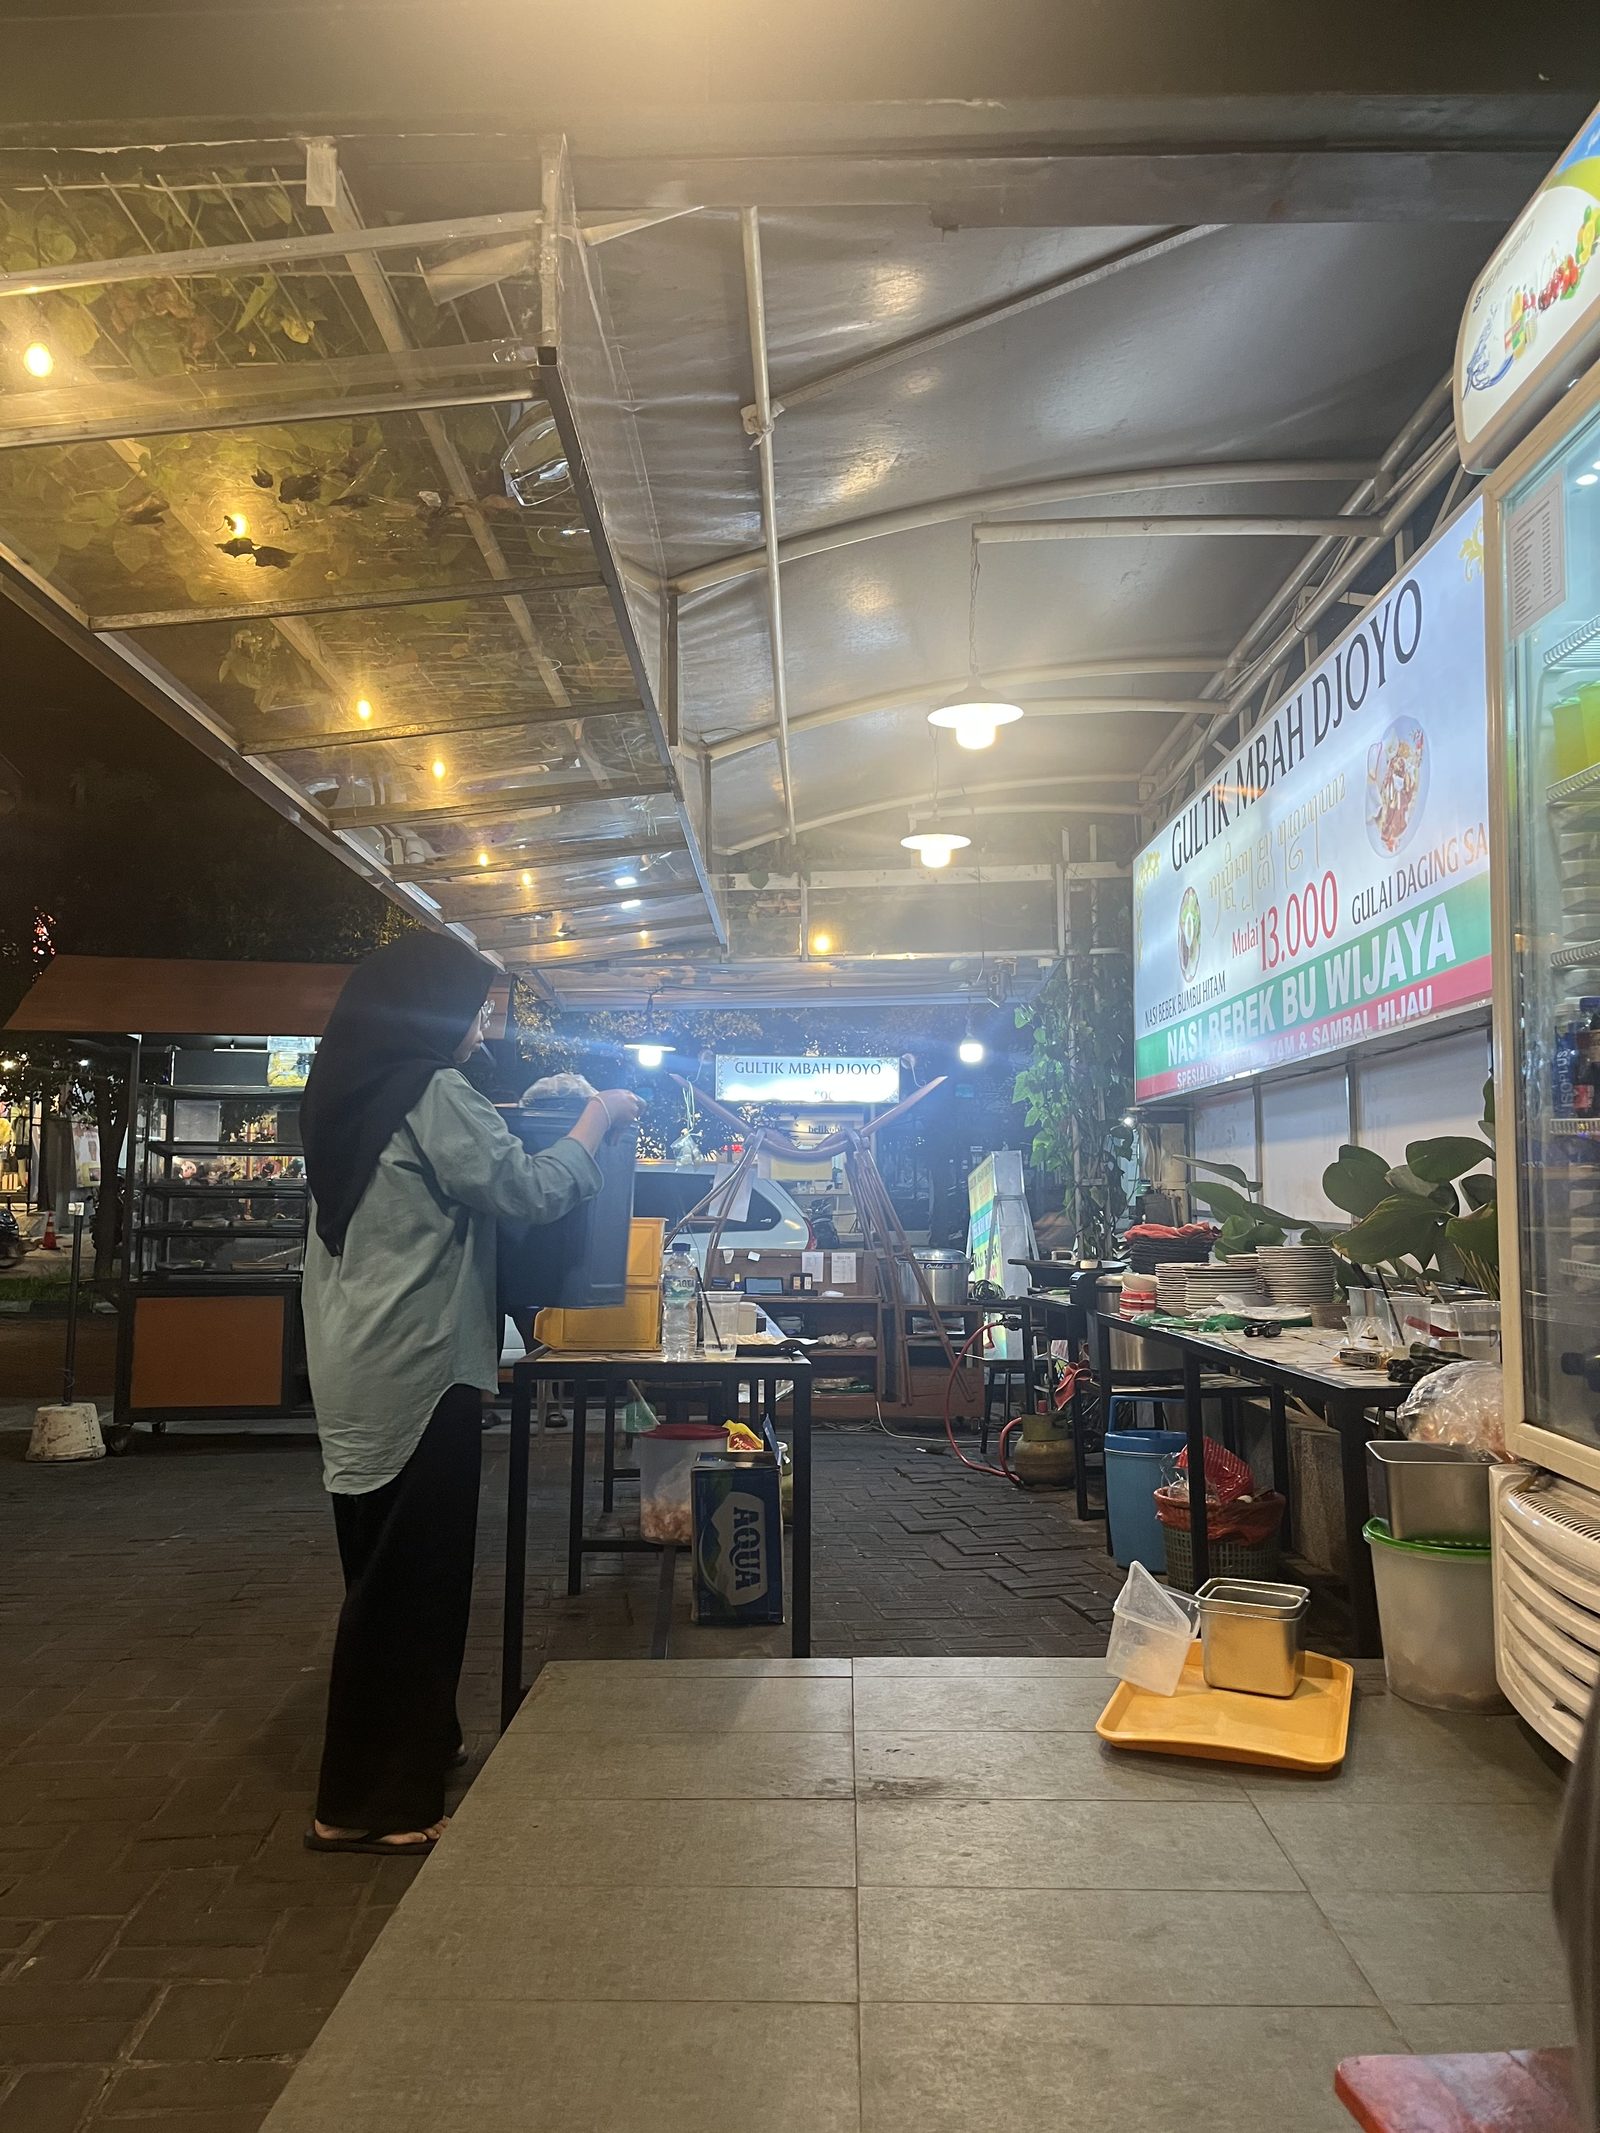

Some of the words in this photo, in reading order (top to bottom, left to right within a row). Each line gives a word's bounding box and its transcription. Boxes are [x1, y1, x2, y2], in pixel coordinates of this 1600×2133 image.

[1171, 771, 1231, 872] GULTIK
[1236, 693, 1305, 818] MBAH
[1312, 578, 1423, 748] DJOYO
[1232, 919, 1259, 959] Mulai
[1260, 870, 1339, 971] 13.000
[1351, 875, 1393, 925] GULAI
[1396, 837, 1459, 903] DAGING
[1144, 1005, 1159, 1029] NASI
[1158, 995, 1177, 1024] BEBEK
[1177, 983, 1202, 1015] BUMBU
[1202, 970, 1227, 1003] HITAM
[1167, 1018, 1204, 1067] NASI
[1207, 985, 1276, 1054] BEBEK
[1281, 966, 1316, 1026] BU
[1324, 902, 1457, 1010] WIJAYA
[1298, 1031, 1308, 1049] &
[1311, 1009, 1371, 1047] SAMBAL
[1377, 985, 1433, 1025] HIJAU
[734, 1062, 784, 1074] GULTIK
[788, 1063, 831, 1075] MBAH
[835, 1063, 881, 1075] DJOYO
[1556, 1048, 1575, 1109] ISOPLUS
[729, 1507, 761, 1591] AQUA
